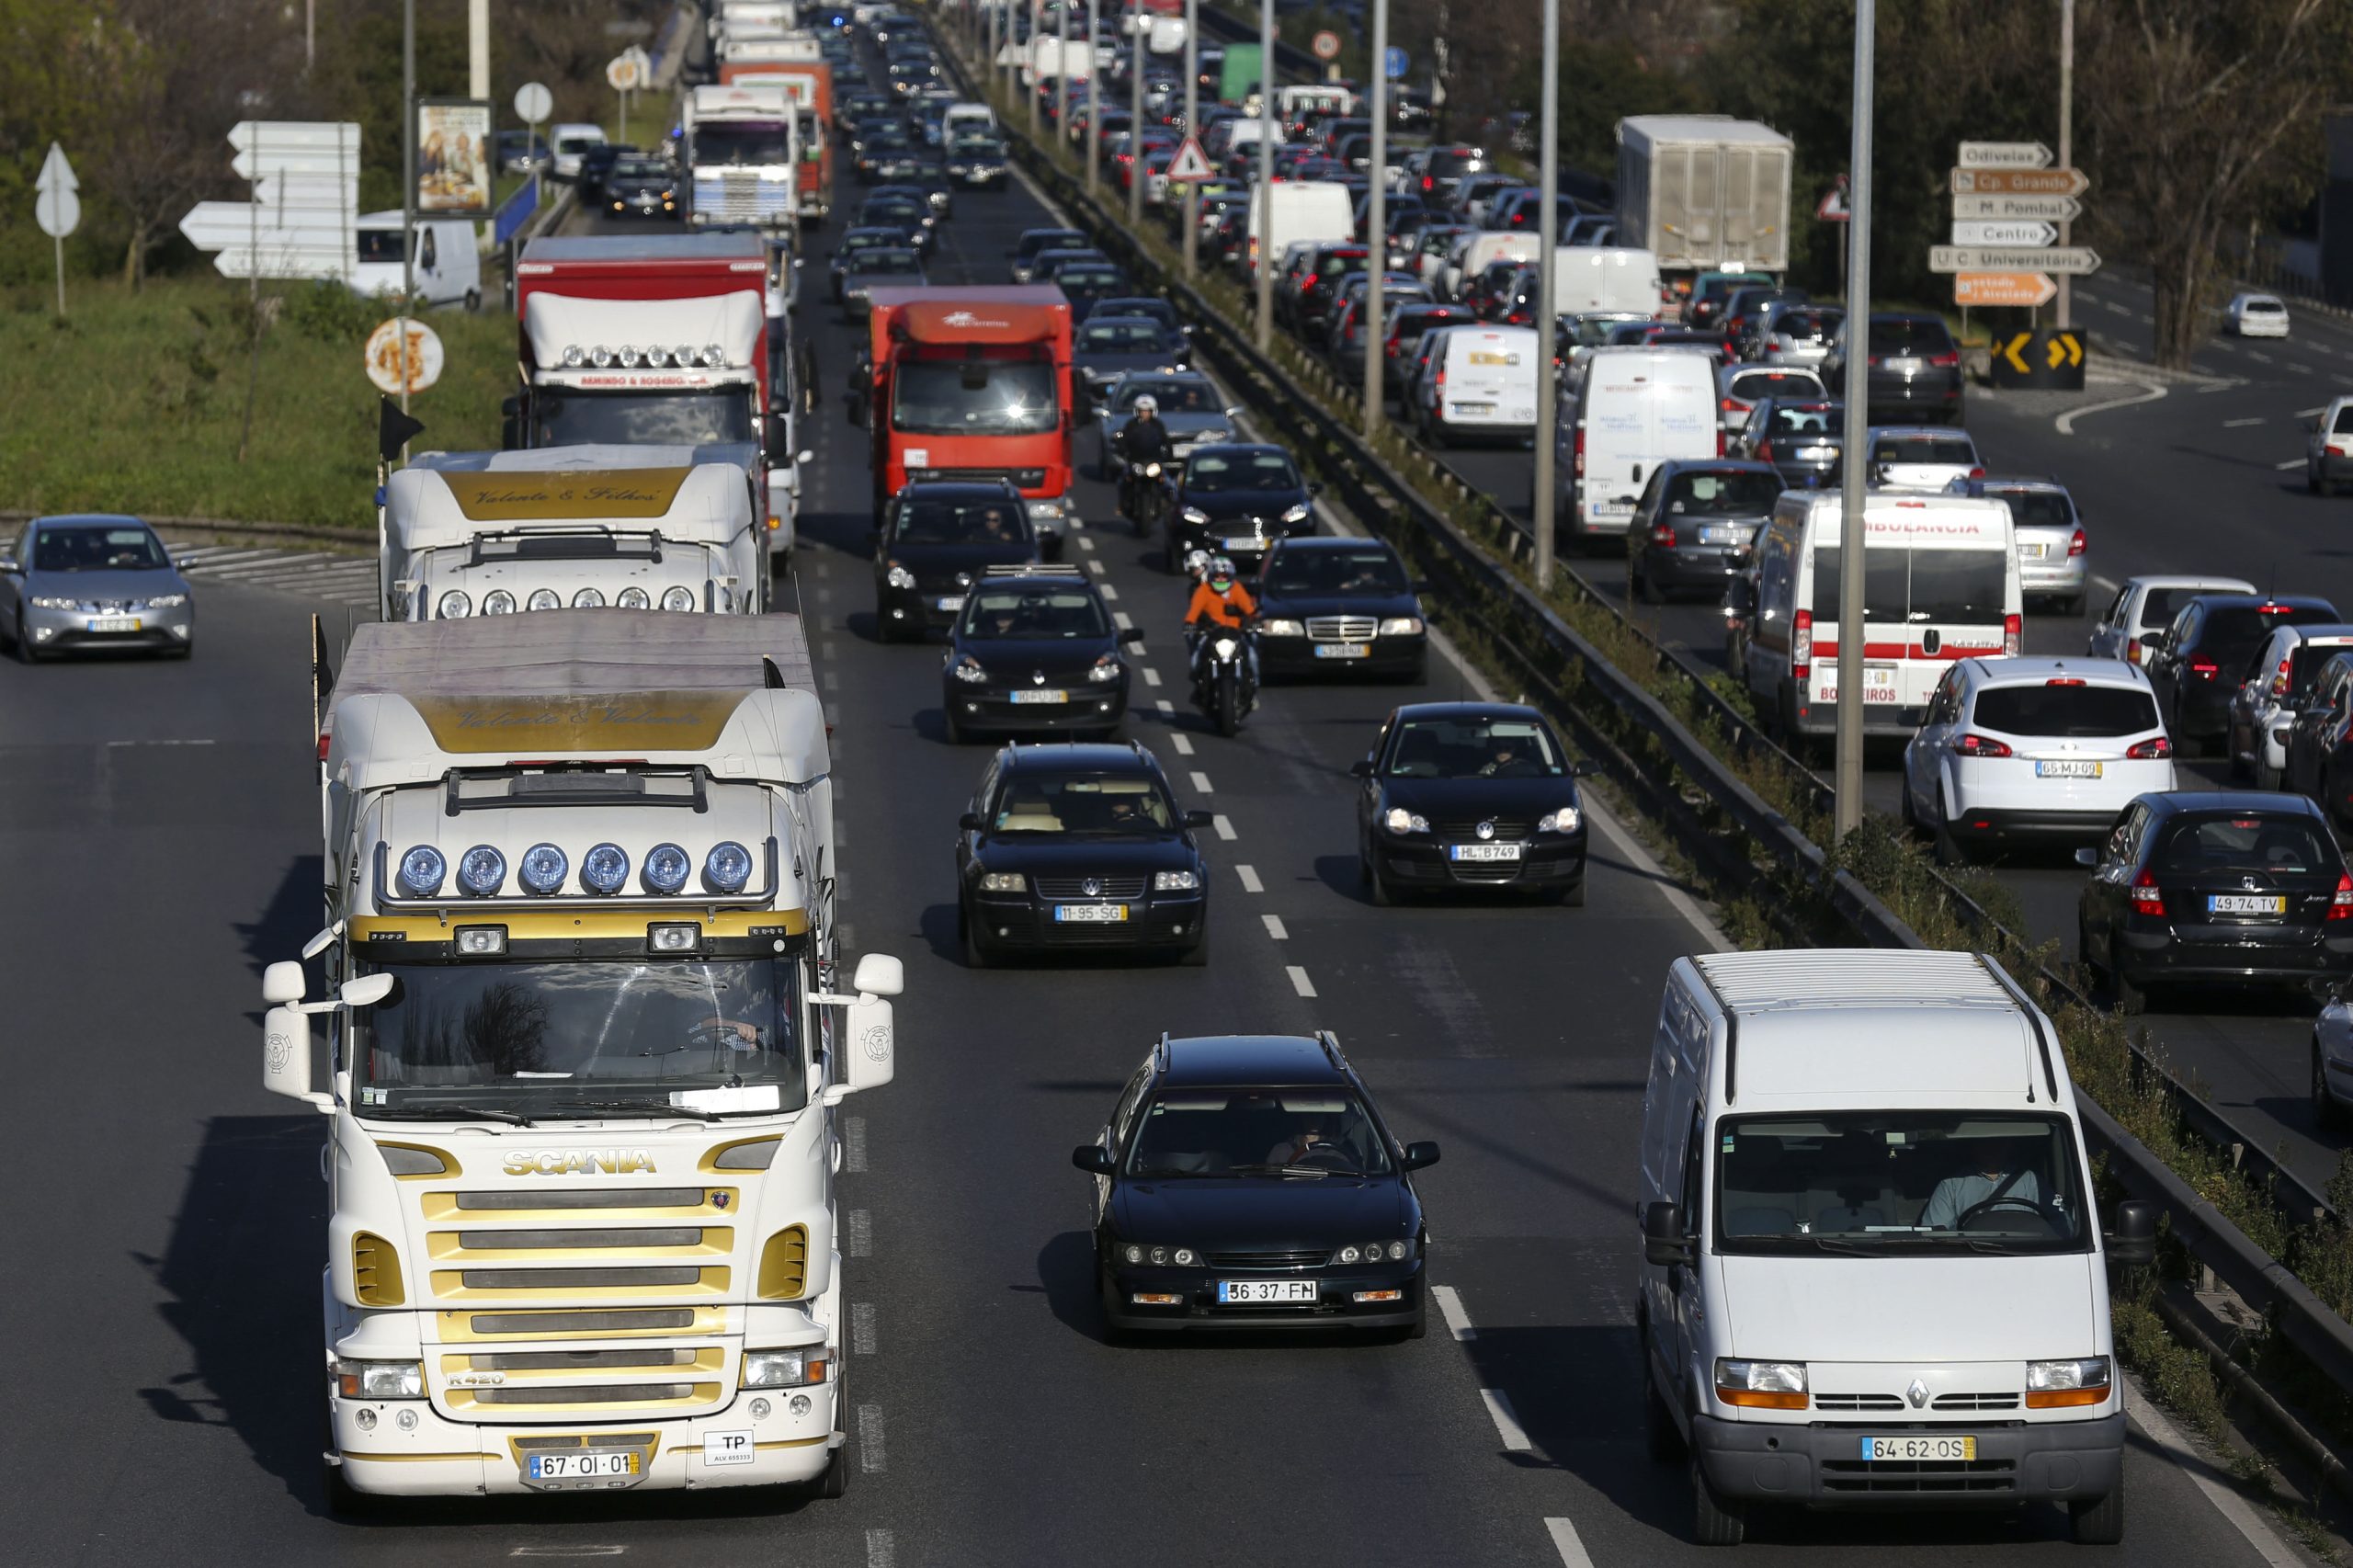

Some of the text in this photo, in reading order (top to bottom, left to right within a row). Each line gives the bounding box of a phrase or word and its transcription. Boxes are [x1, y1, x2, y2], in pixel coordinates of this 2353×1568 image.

[1965, 147, 2034, 163] Odivelas
[2011, 175, 2069, 187] Grande
[2004, 201, 2063, 214] Pombal
[1983, 227, 2039, 241] Centro
[475, 490, 550, 505] Valente
[559, 490, 574, 501] &
[1821, 687, 1896, 702] BOIROS
[455, 706, 704, 728] Valente & Valente
[502, 1148, 657, 1176] SCANIA
[449, 1374, 505, 1385] R 420
[722, 1436, 745, 1449] TP
